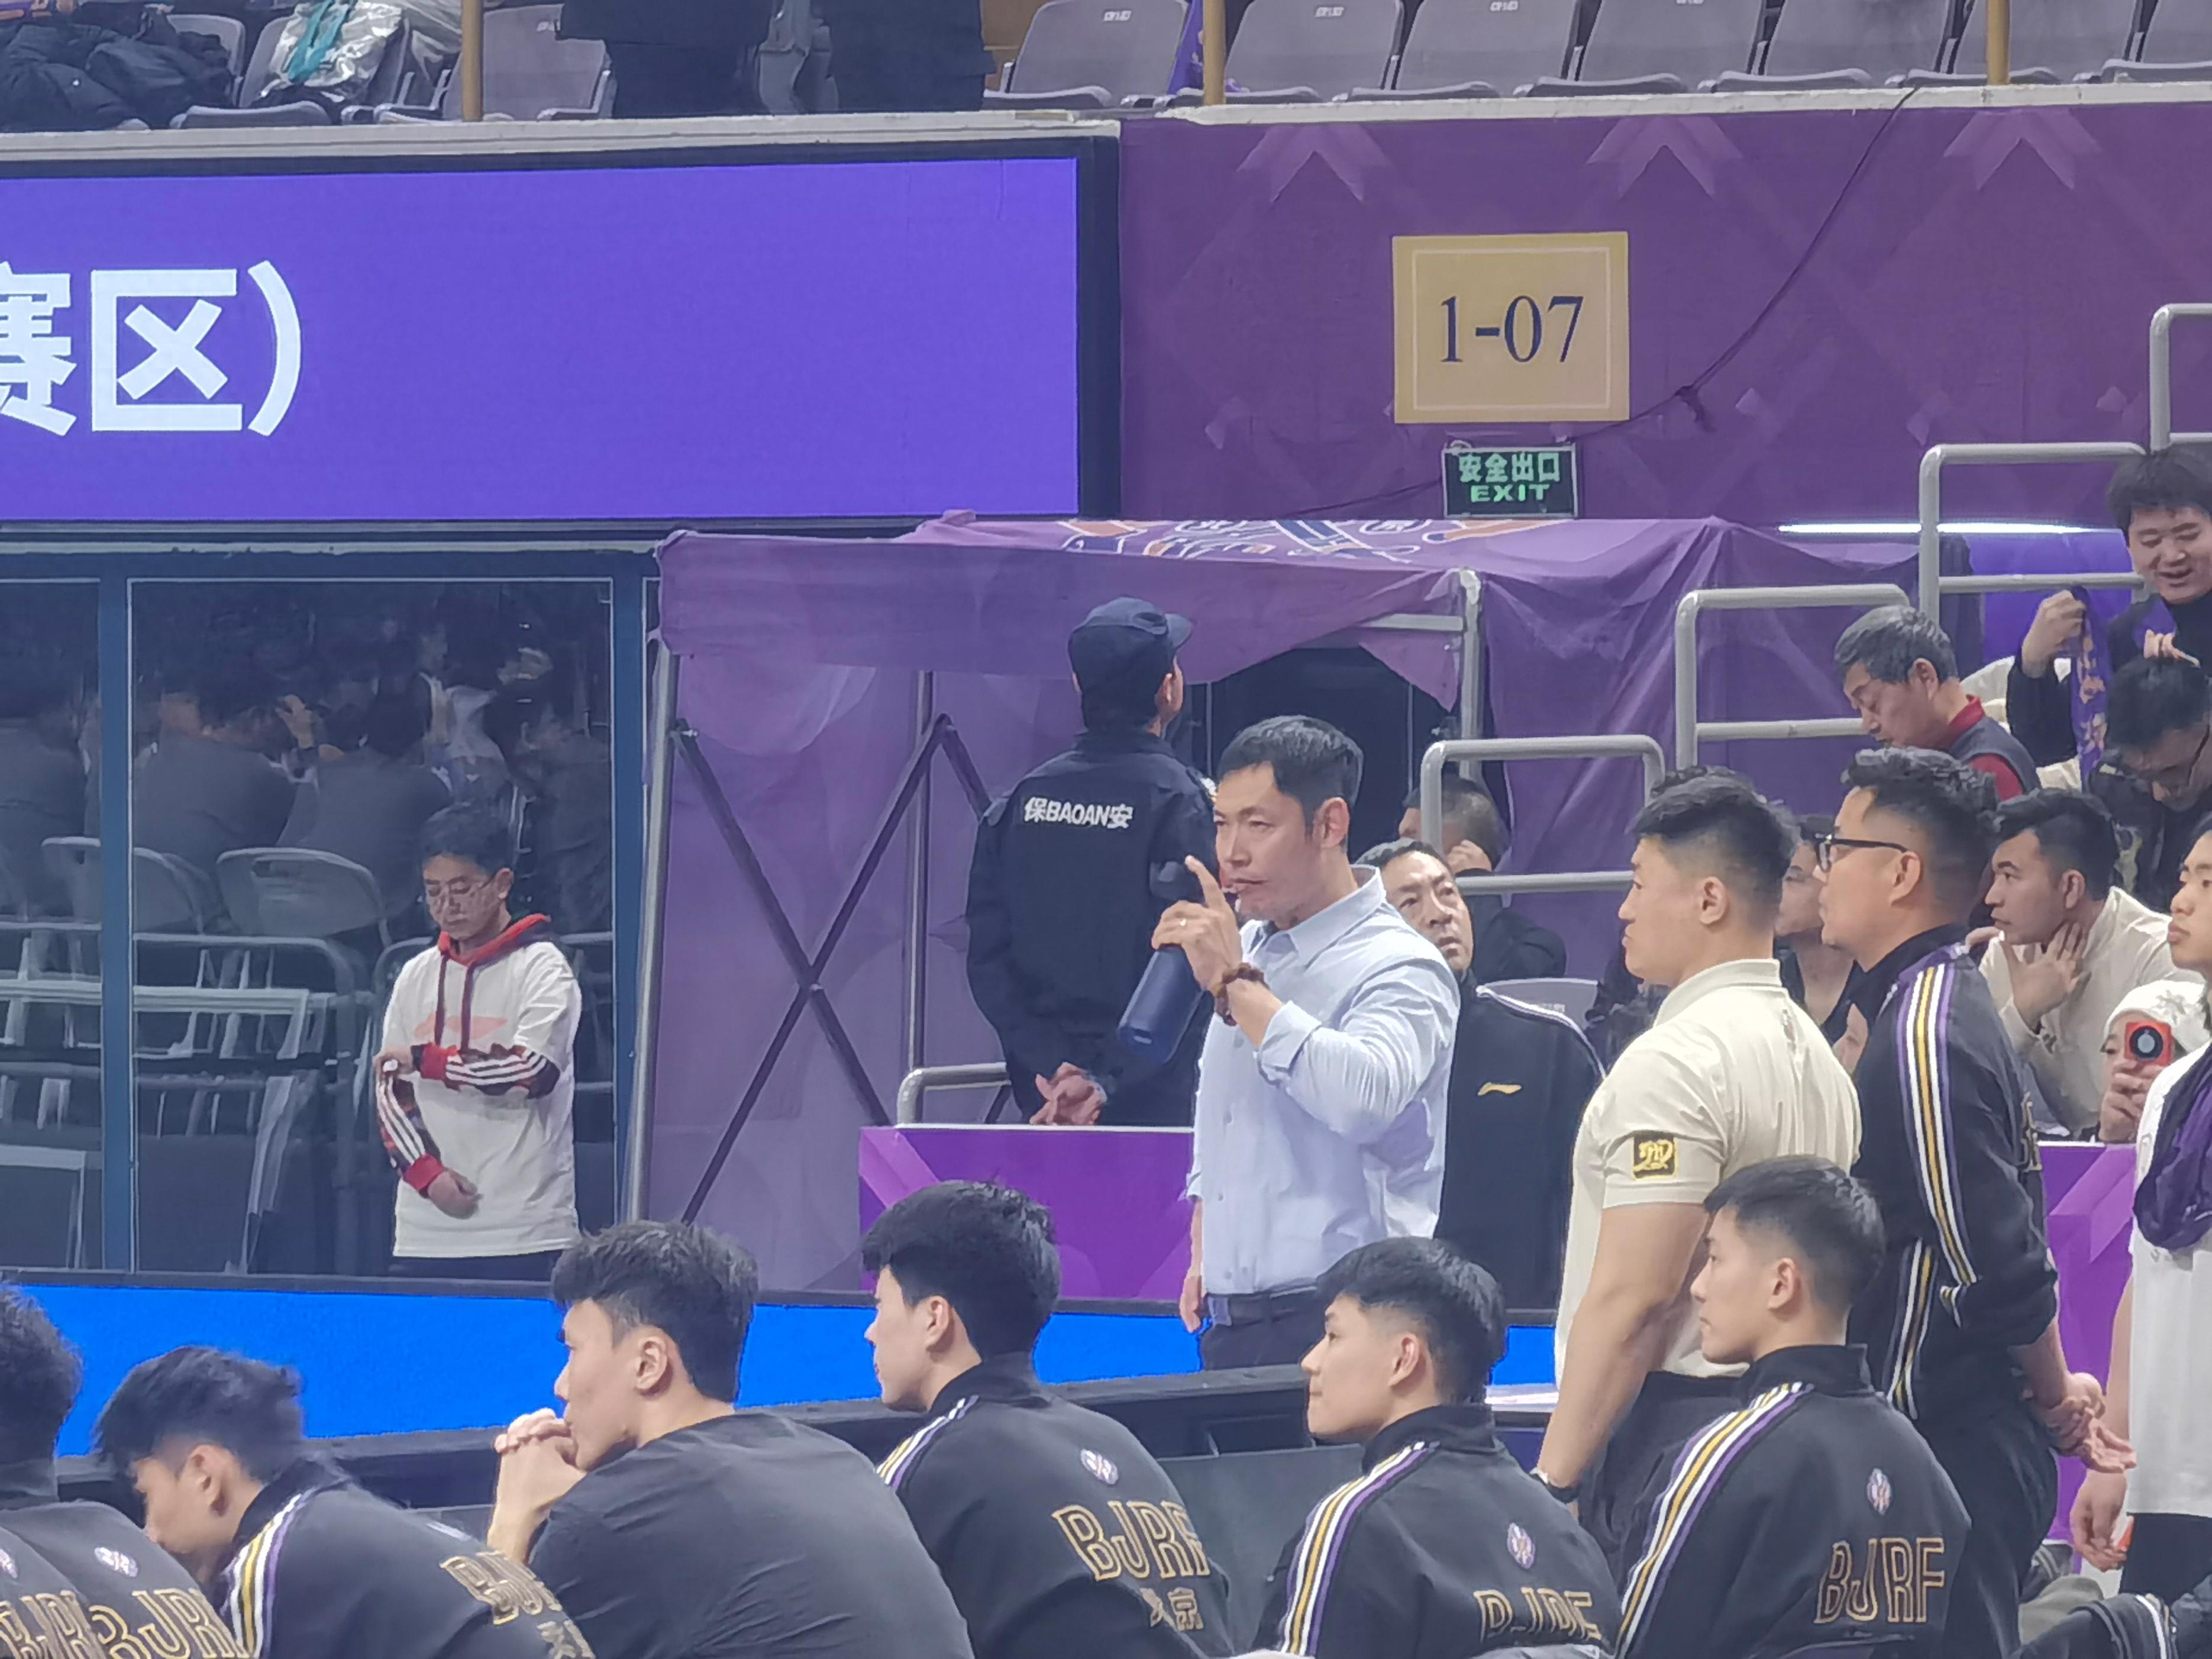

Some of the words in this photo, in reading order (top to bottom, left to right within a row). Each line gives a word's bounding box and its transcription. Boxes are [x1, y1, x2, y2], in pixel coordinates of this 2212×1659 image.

[1441, 295, 1584, 363] 1-07
[1458, 452, 1560, 483] 安全出口
[1470, 484, 1550, 503] EXIT
[1813, 1537, 1945, 1624] BJRF
